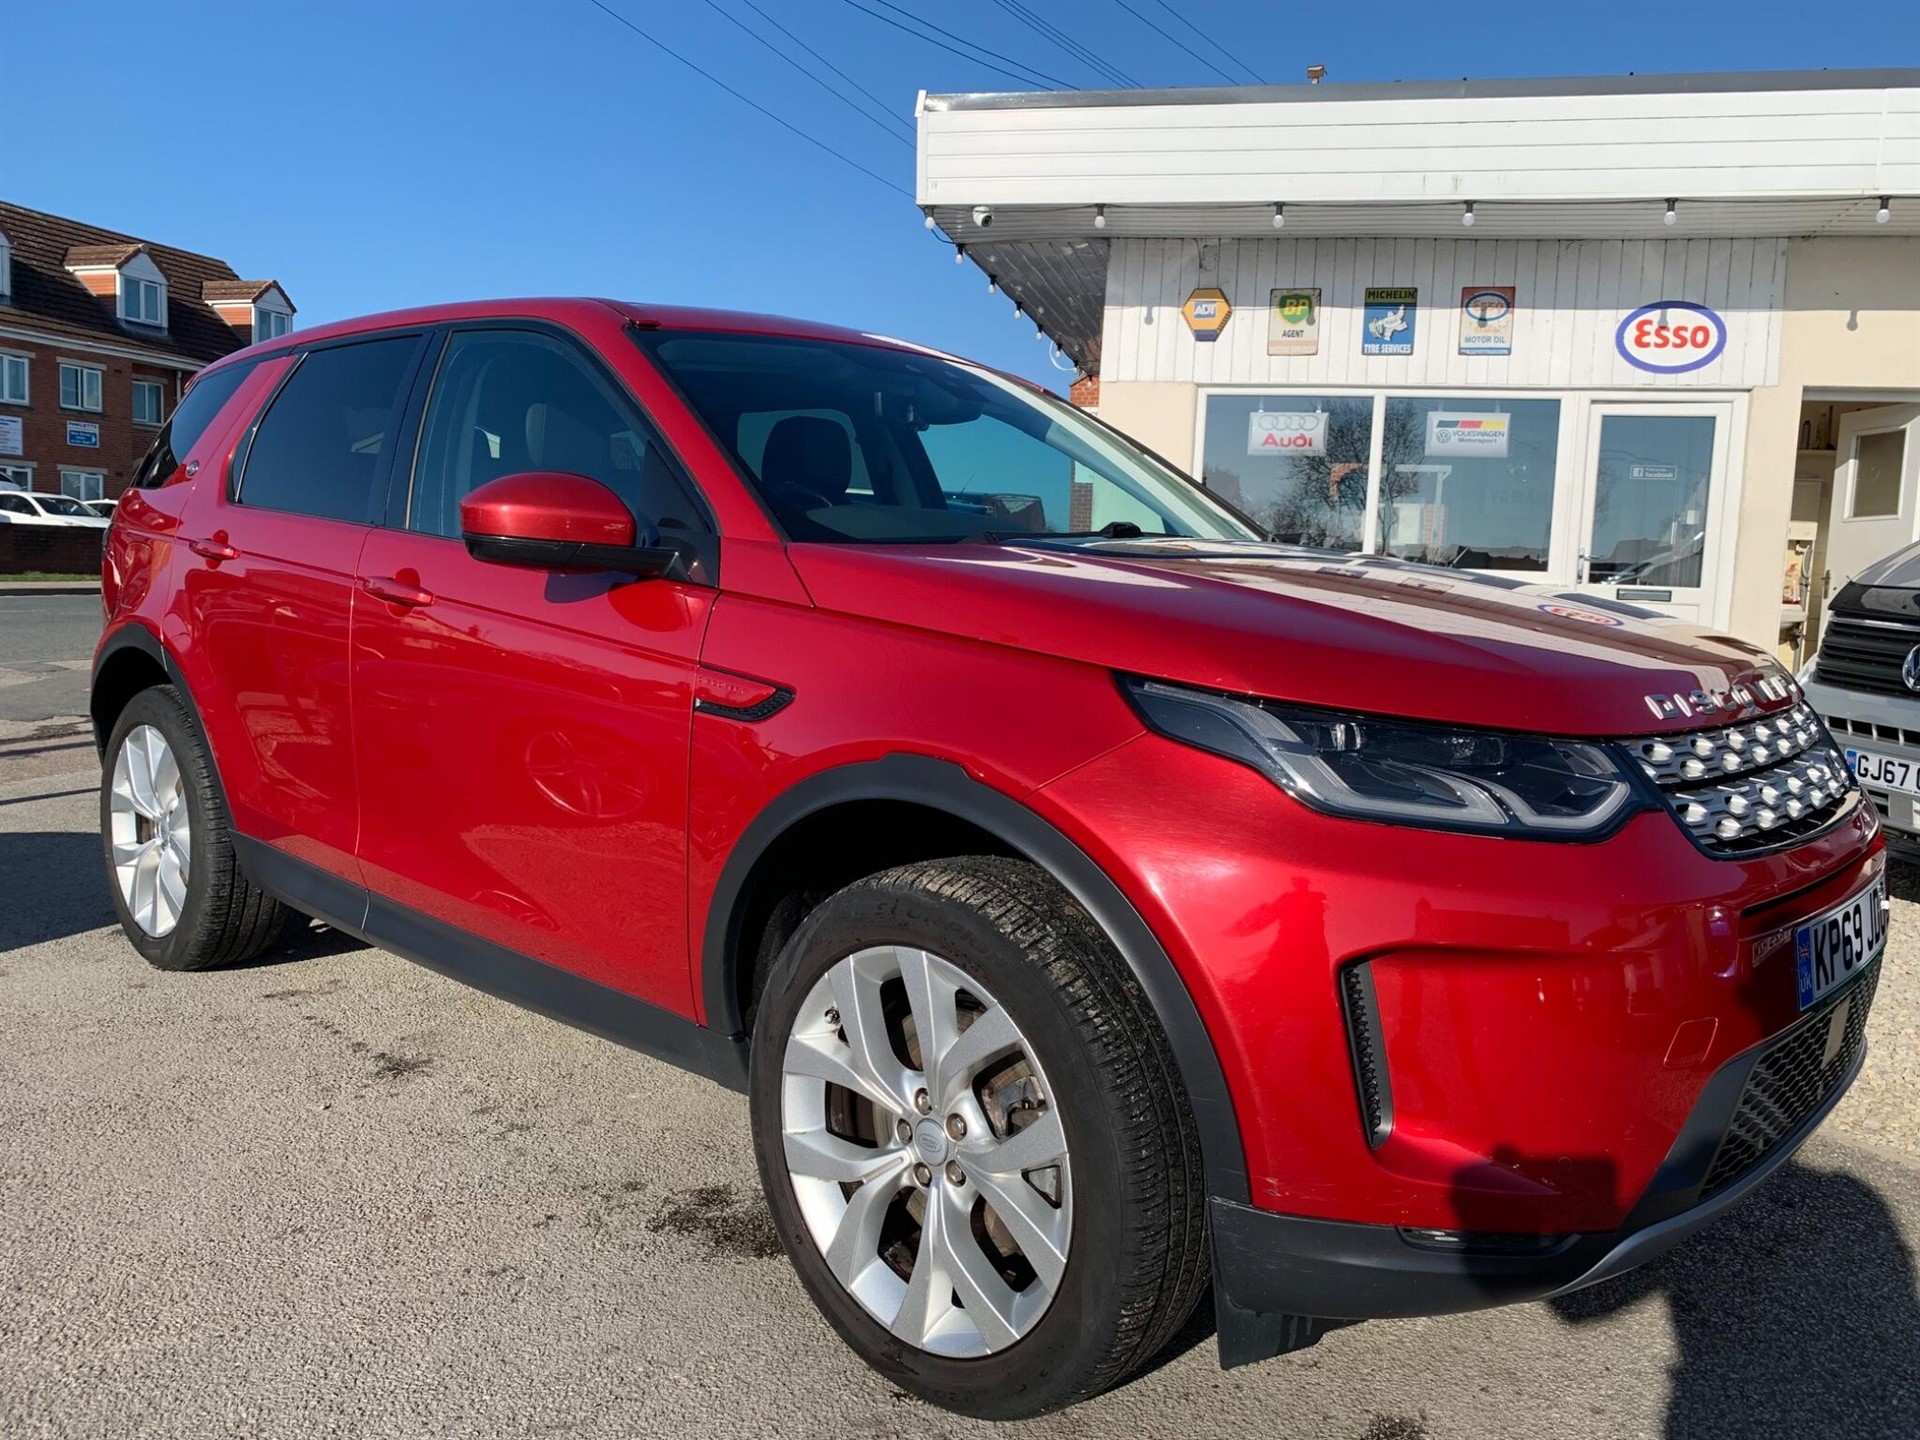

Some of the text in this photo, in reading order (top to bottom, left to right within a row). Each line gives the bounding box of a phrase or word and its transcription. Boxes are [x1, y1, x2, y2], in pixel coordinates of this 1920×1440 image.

[1367, 290, 1416, 300] MICHELIN
[1193, 302, 1217, 315] ADT
[1283, 299, 1310, 315] BP
[1281, 329, 1304, 338] AGENT
[1464, 335, 1506, 343] MOTOR OIL
[1363, 343, 1411, 354] TYRE SERVICES
[1857, 755, 1910, 787] GJ67
[1813, 903, 1863, 991] KP69
[1800, 971, 1812, 993] UK
